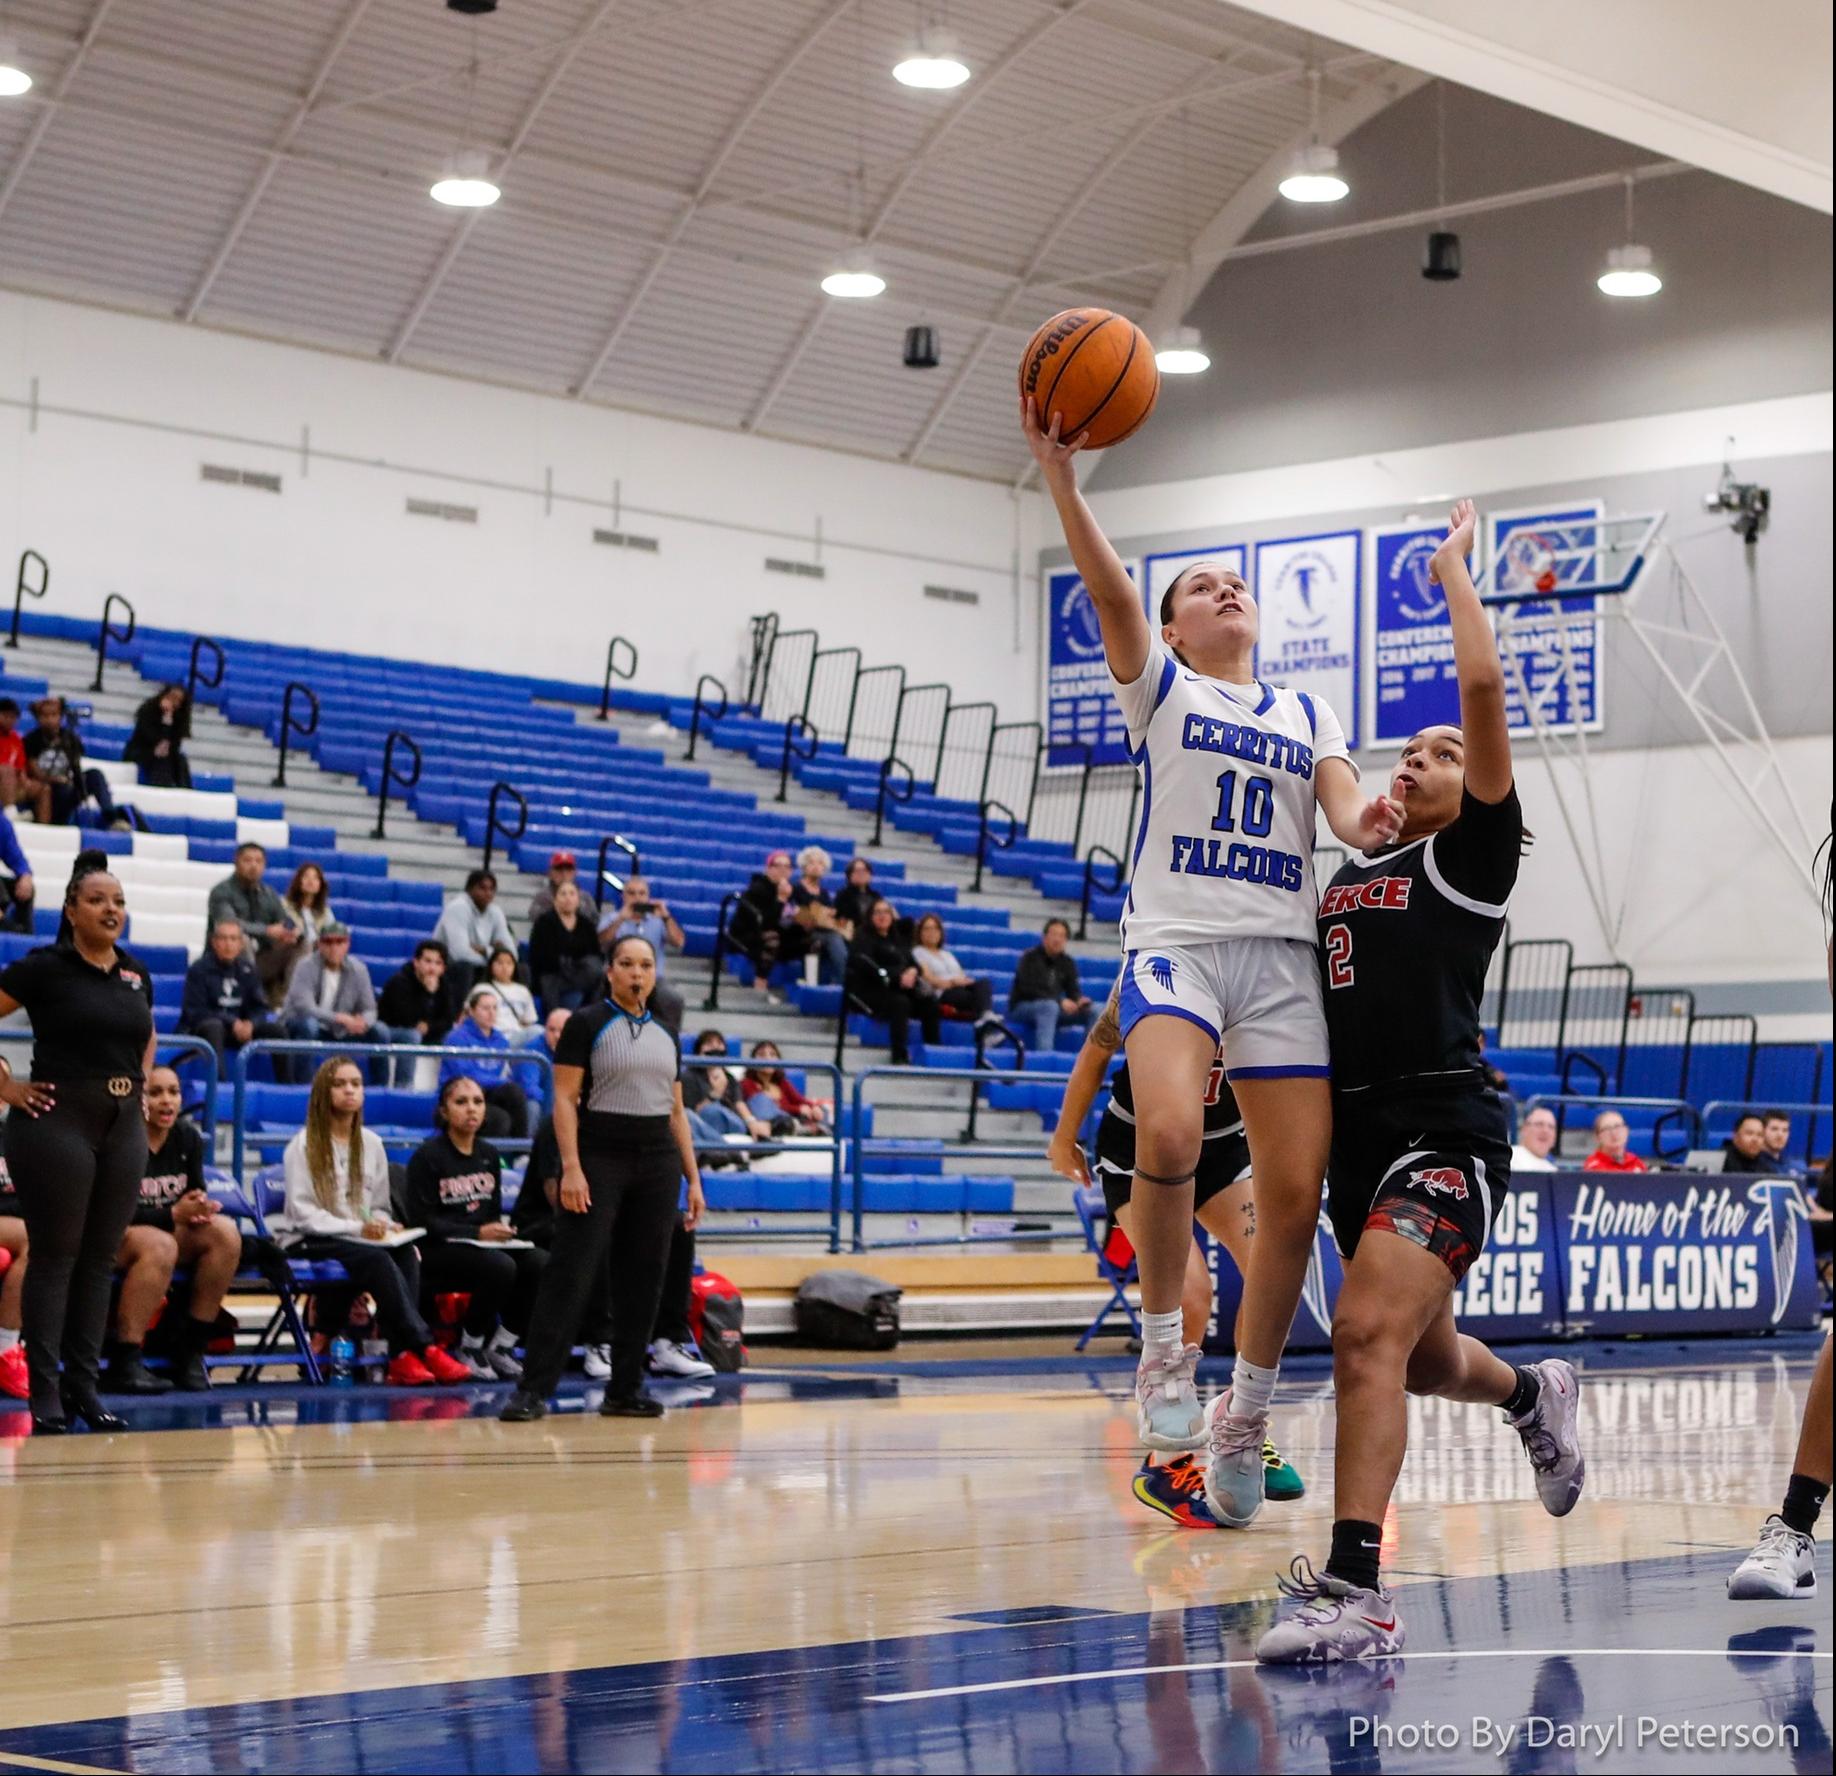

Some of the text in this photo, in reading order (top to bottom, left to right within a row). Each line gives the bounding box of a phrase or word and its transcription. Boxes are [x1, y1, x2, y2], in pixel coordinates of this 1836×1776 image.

[1025, 315, 1089, 394] Wilson
[1262, 653, 1350, 676] CHAMPIONS
[1282, 637, 1329, 656] STATE
[1182, 713, 1313, 781] CERRITOS
[1211, 770, 1274, 838] 10
[1170, 835, 1303, 892] FALCONS
[1318, 876, 1412, 919] ERCE
[1326, 923, 1355, 990] 2
[1568, 1184, 1660, 1240] Home
[1661, 1186, 1699, 1239] of
[1700, 1187, 1750, 1239] the
[1568, 1245, 1759, 1312] FALCONS
